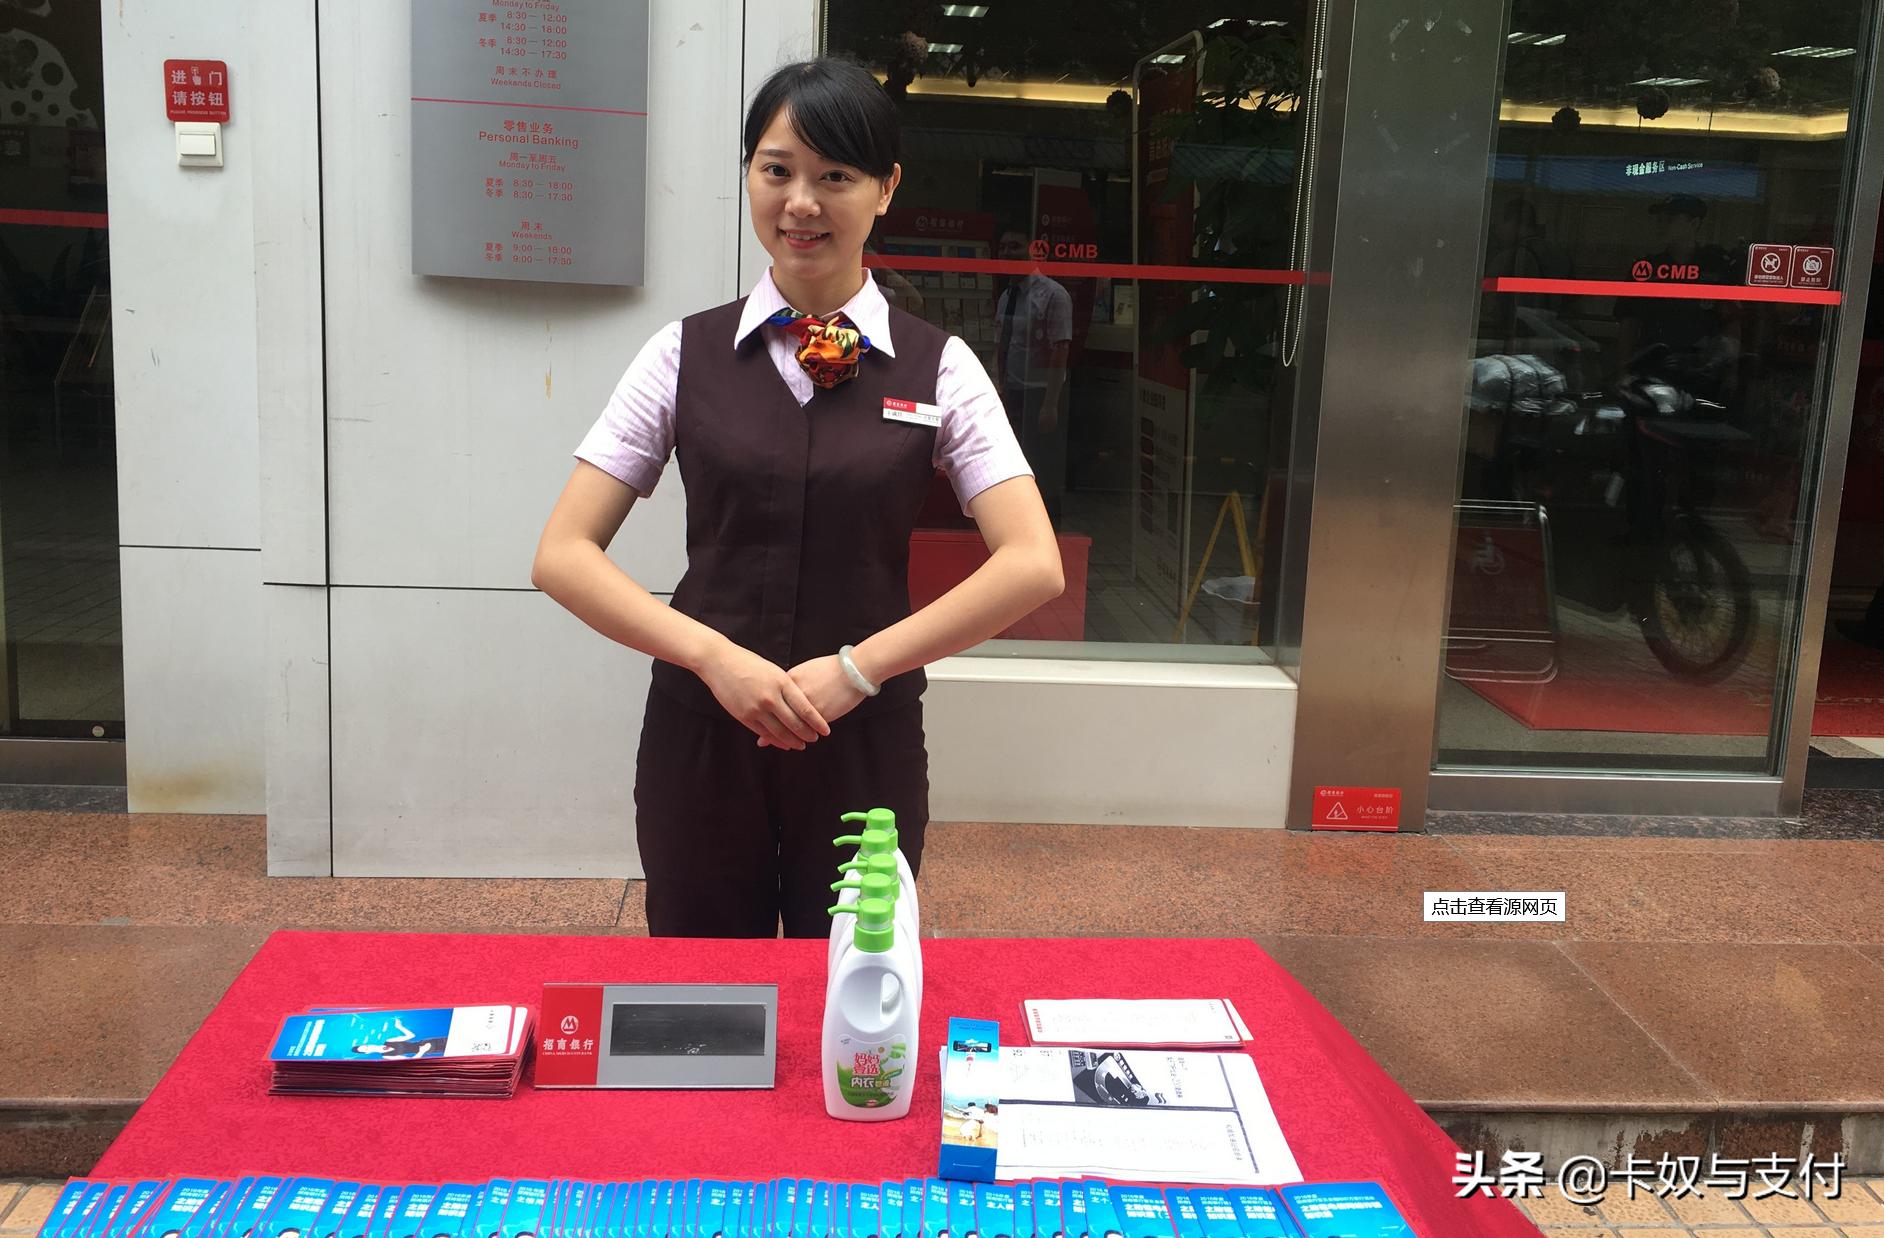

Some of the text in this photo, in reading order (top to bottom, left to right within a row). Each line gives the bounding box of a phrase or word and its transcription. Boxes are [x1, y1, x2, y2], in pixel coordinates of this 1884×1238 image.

[535, 1, 560, 12] Friday
[171, 91, 225, 106] 请按钮
[504, 120, 554, 134] 零售业务
[479, 131, 579, 149] Personal Banking
[499, 160, 530, 170] Monday
[531, 162, 540, 170] to
[1054, 243, 1098, 259] CMB
[1657, 264, 1700, 280] CMB
[1357, 805, 1394, 815] 小心台阶
[543, 1038, 594, 1051] 招商银行
